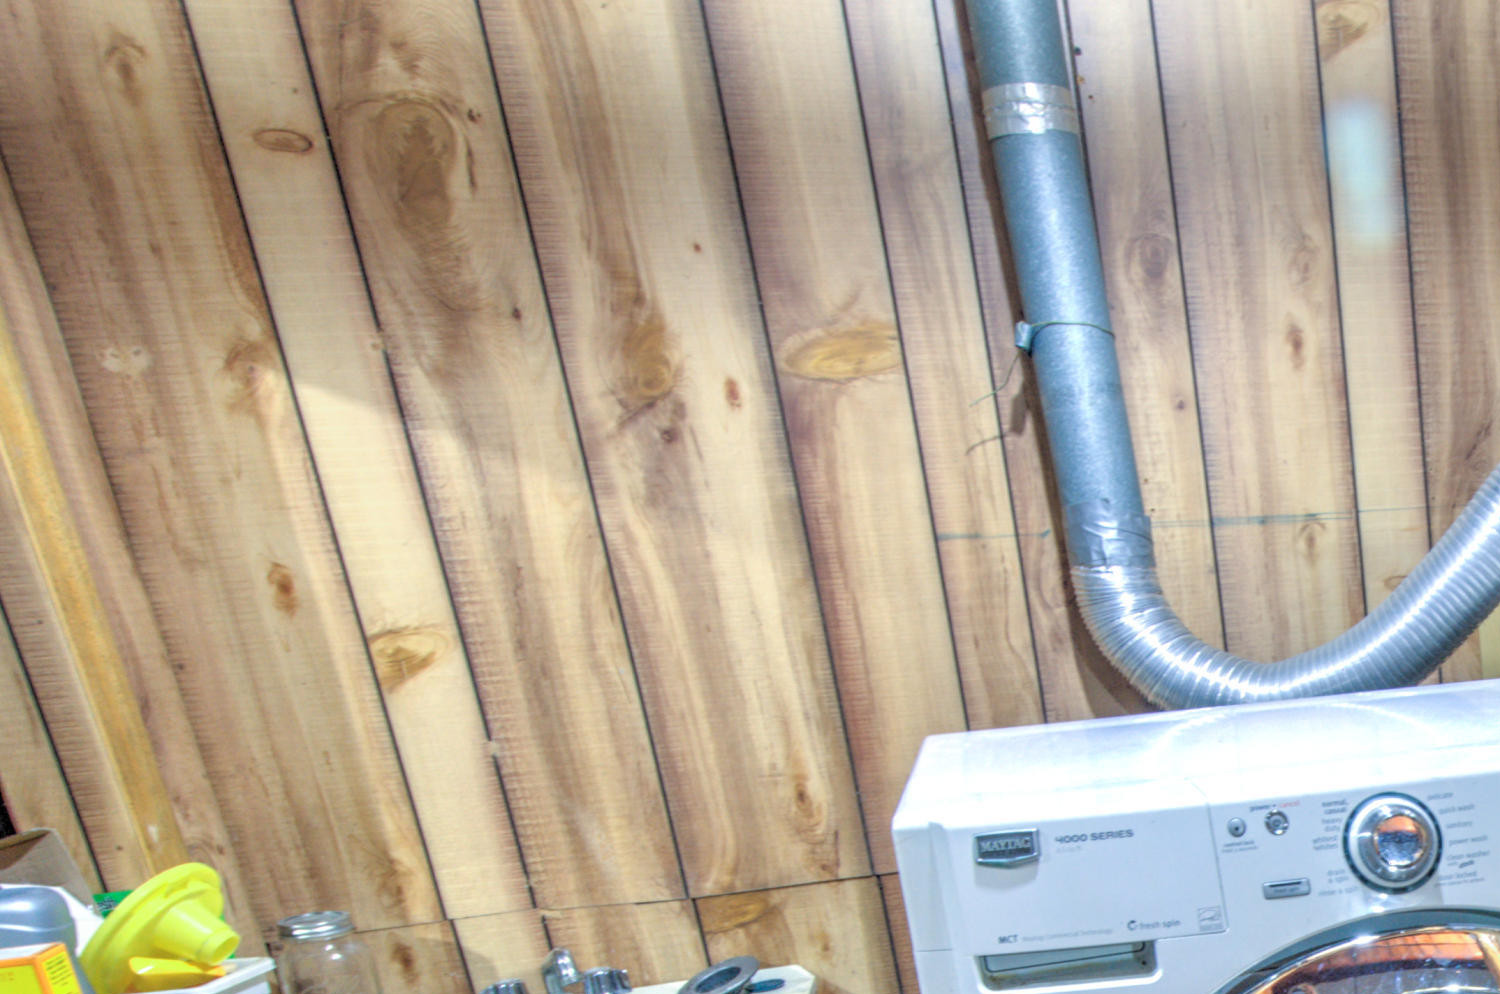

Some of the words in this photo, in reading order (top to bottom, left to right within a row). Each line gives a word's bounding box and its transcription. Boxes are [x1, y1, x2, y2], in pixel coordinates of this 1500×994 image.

[1054, 833, 1088, 844] 4000
[1090, 829, 1135, 841] SERIES
[980, 836, 1032, 853] MAYTAG
[998, 934, 1019, 944] MCT
